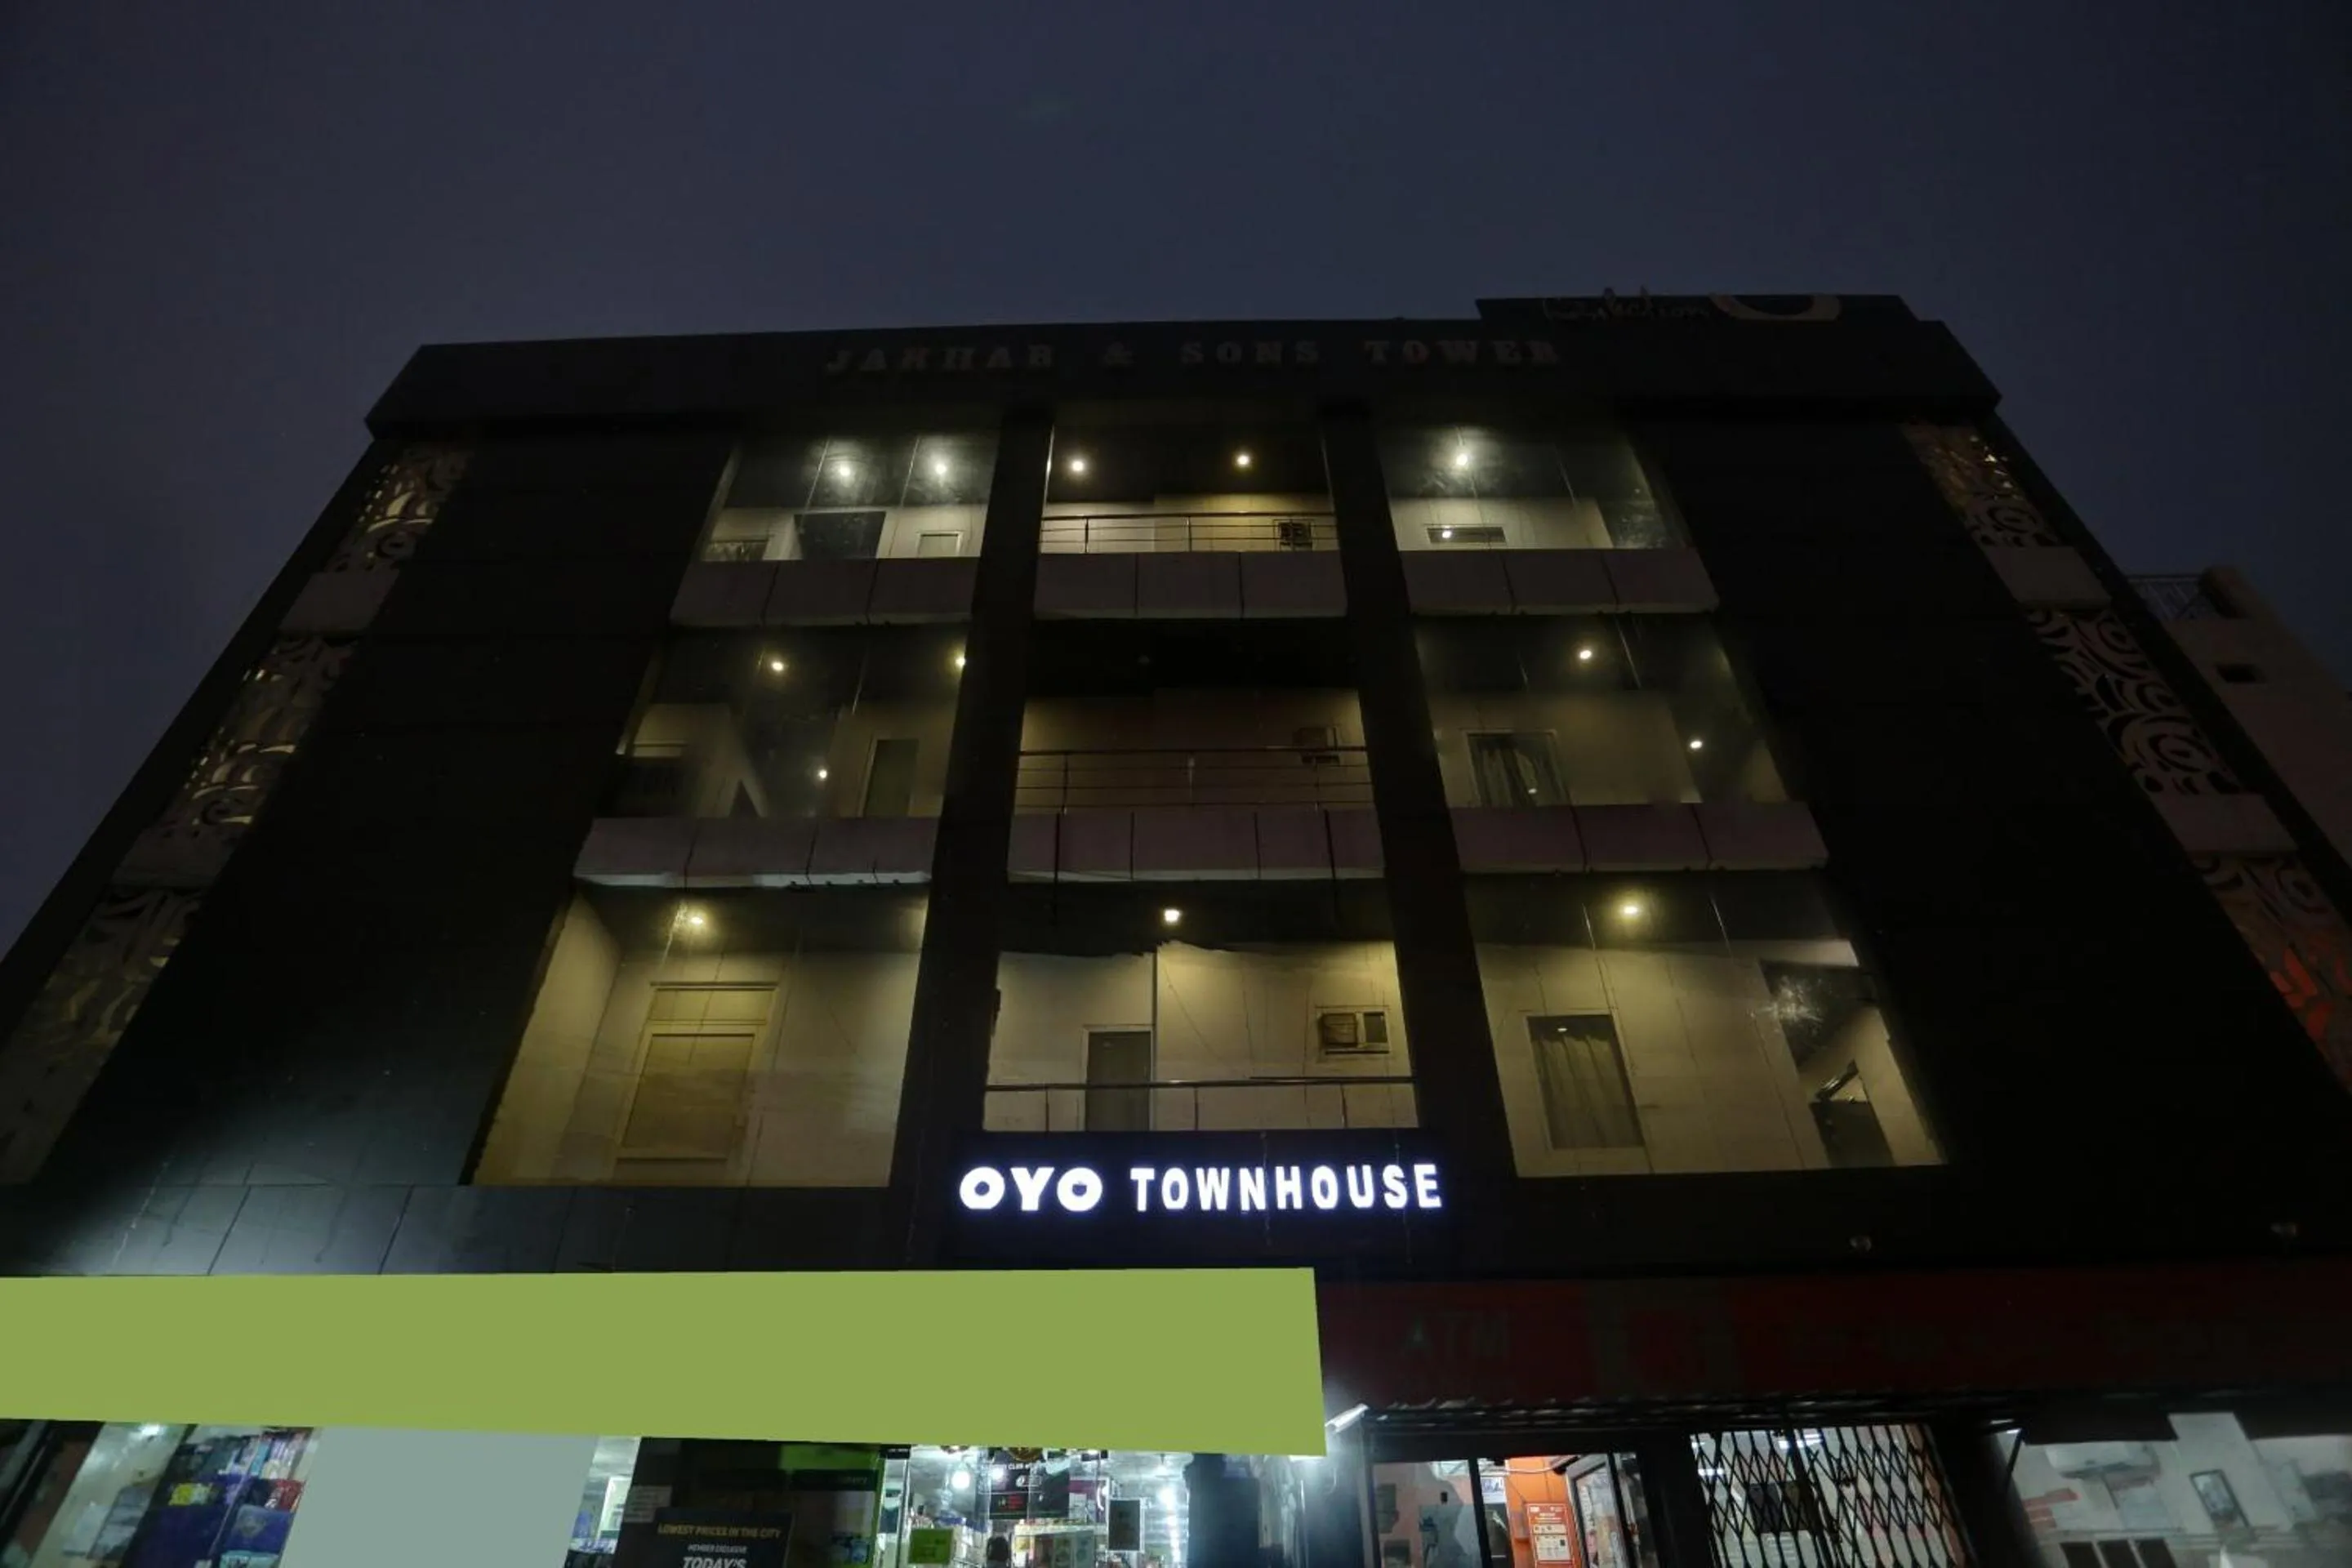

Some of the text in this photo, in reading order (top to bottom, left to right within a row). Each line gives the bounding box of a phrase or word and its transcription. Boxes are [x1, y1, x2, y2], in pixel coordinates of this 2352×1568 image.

[1102, 340, 1135, 368] &
[1179, 339, 1320, 366] SONS
[1363, 339, 1560, 367] TOWER
[959, 1163, 1443, 1213] OYO TOWNHOUSE
[1401, 1310, 1511, 1359] ATM
[657, 1522, 782, 1539] LOWEST PRICES IN THE CITY
